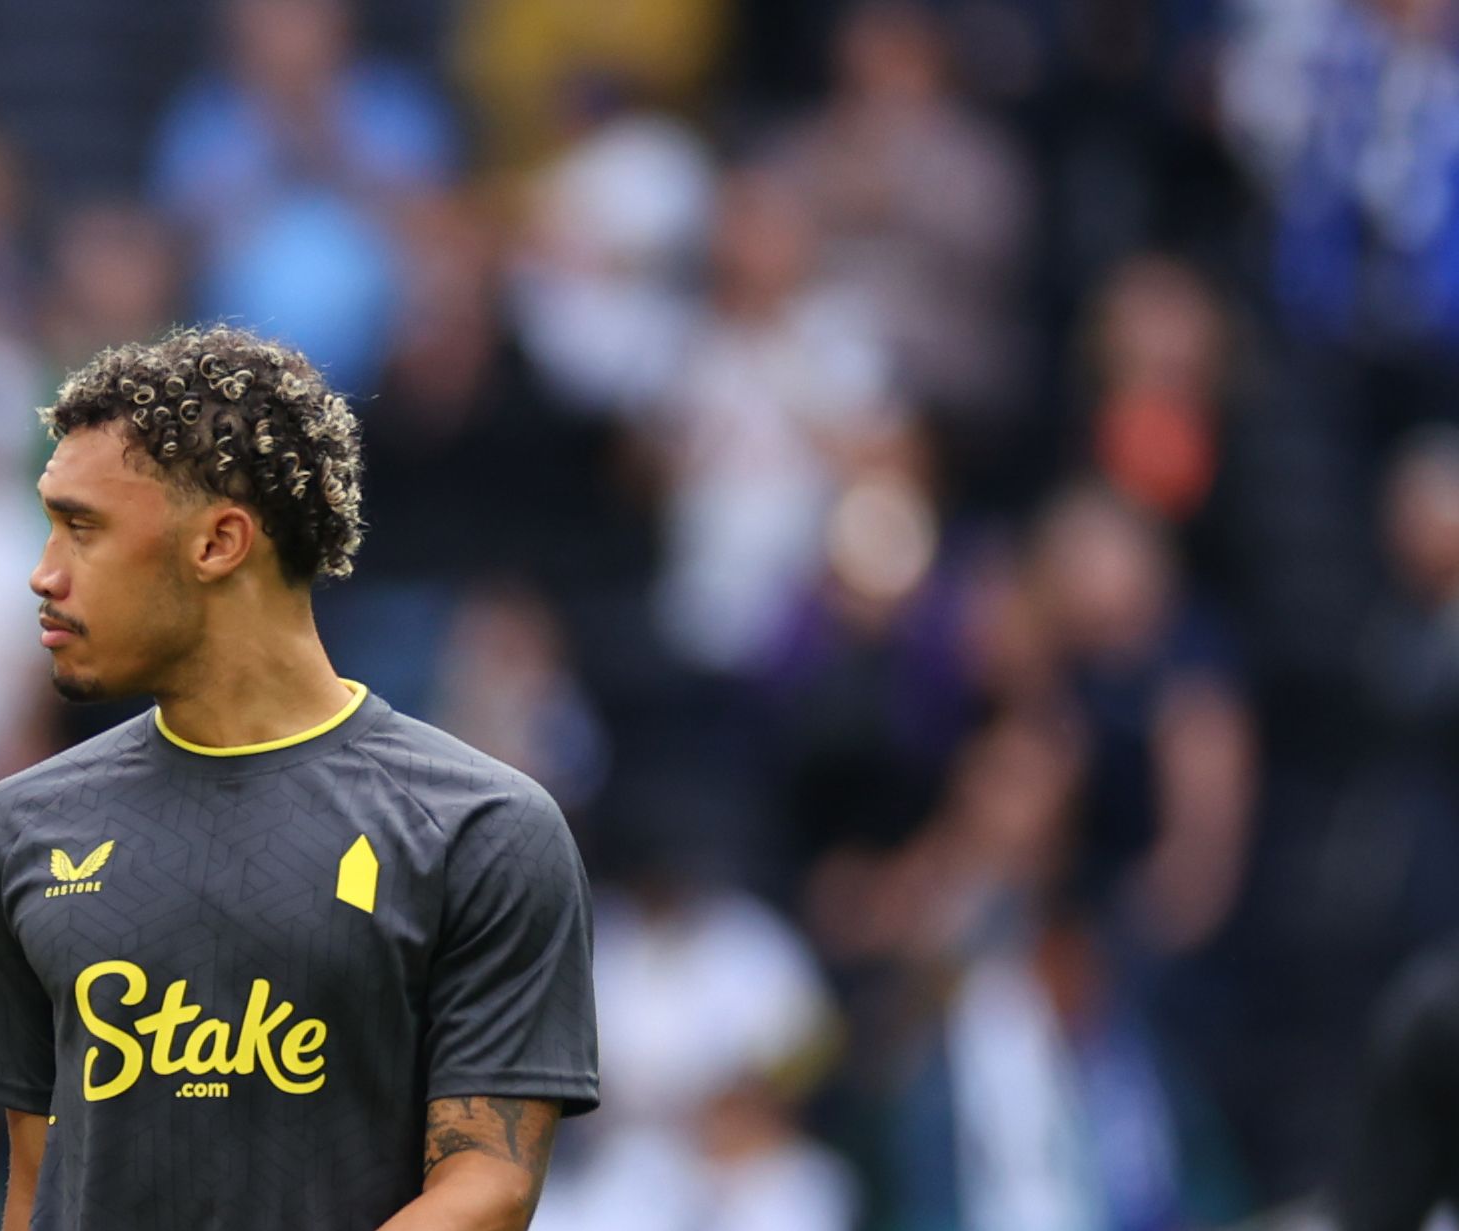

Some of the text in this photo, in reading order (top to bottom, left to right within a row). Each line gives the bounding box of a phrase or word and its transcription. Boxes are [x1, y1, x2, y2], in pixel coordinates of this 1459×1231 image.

[44, 881, 102, 899] CASTORE
[74, 959, 328, 1102] Stake
[175, 1081, 230, 1098] .com
